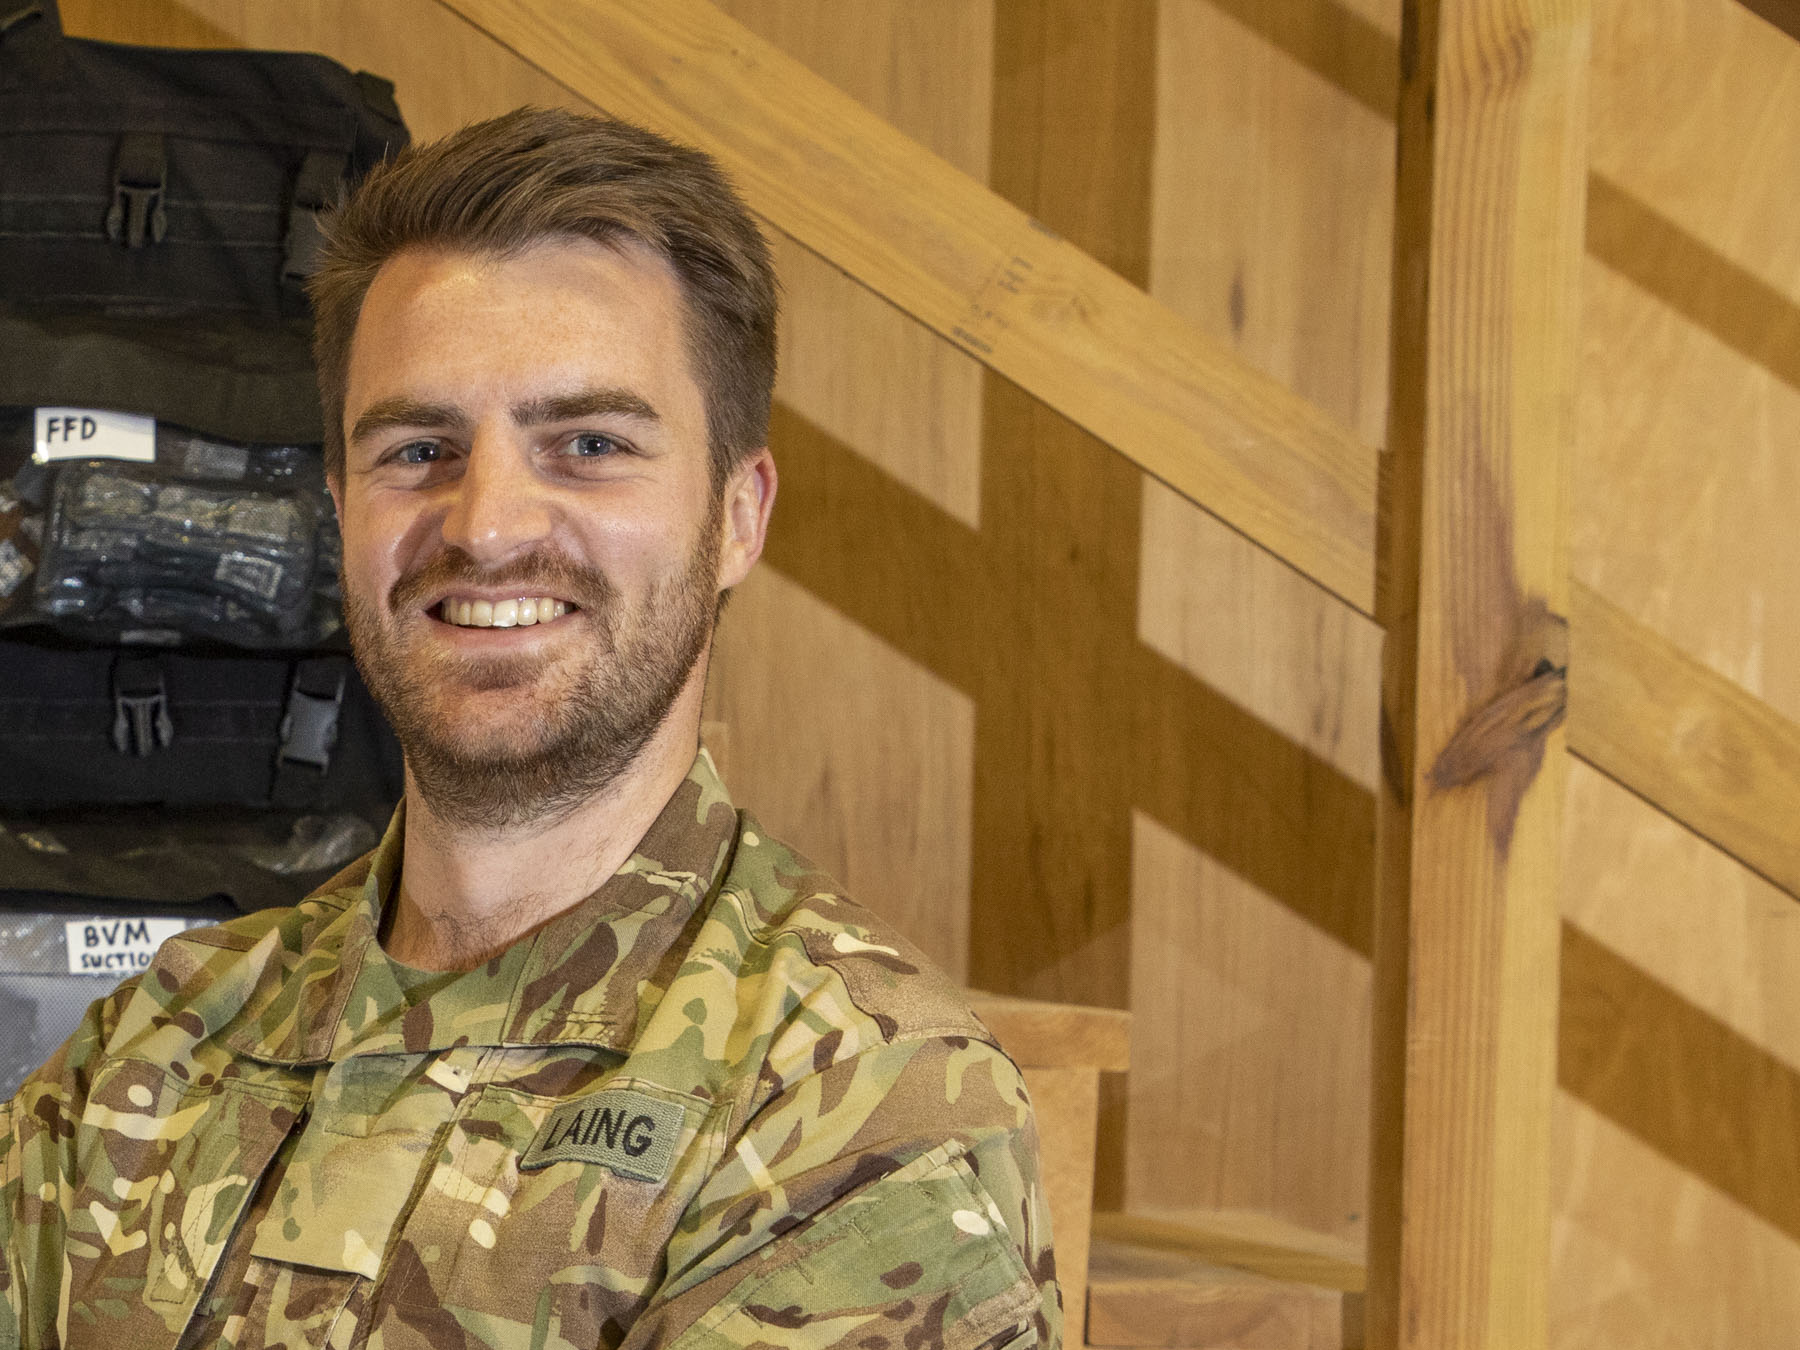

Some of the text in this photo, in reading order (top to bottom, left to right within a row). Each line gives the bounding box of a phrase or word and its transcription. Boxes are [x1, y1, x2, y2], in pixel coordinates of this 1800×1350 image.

[47, 415, 97, 443] FFD
[84, 919, 151, 947] BVM
[81, 952, 157, 969] SUCTIO
[541, 1106, 657, 1158] LAING
